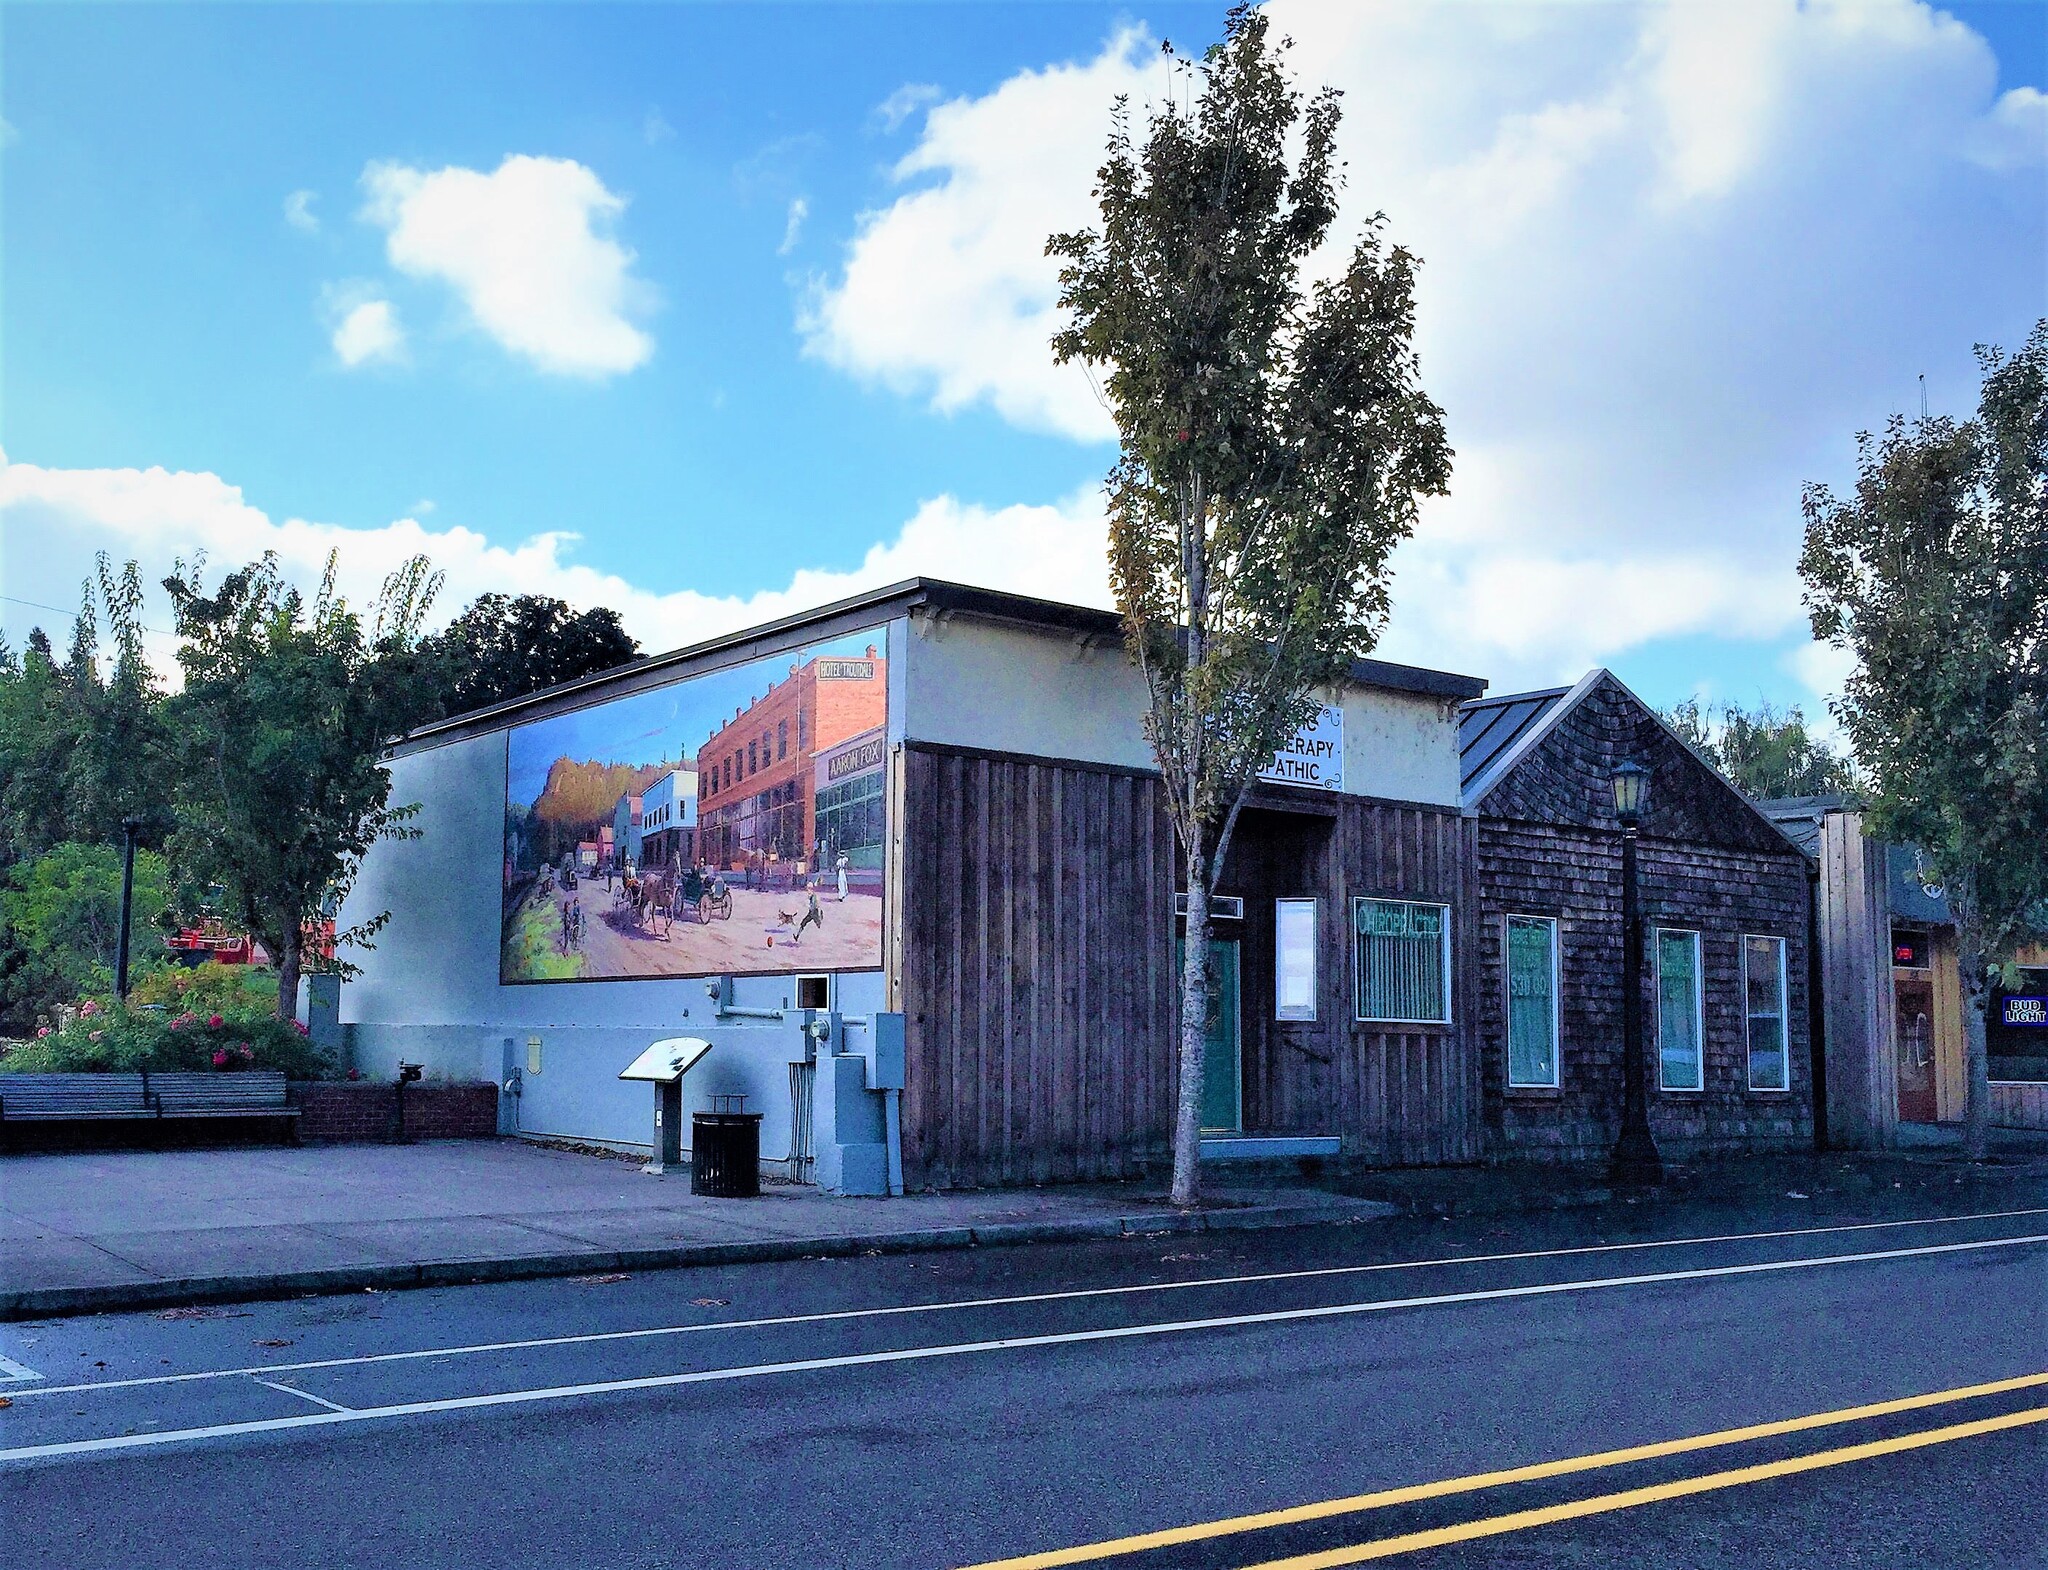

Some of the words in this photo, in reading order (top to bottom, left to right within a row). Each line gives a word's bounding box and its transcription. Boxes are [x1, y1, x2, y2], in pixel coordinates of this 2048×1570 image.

[820, 661, 841, 678] HOTEL
[1286, 737, 1334, 759] ERAPY
[830, 749, 858, 776] AARON
[859, 740, 880, 765] FOX
[2010, 1000, 2041, 1011] BUD
[2005, 1011, 2047, 1023] LIGHT
